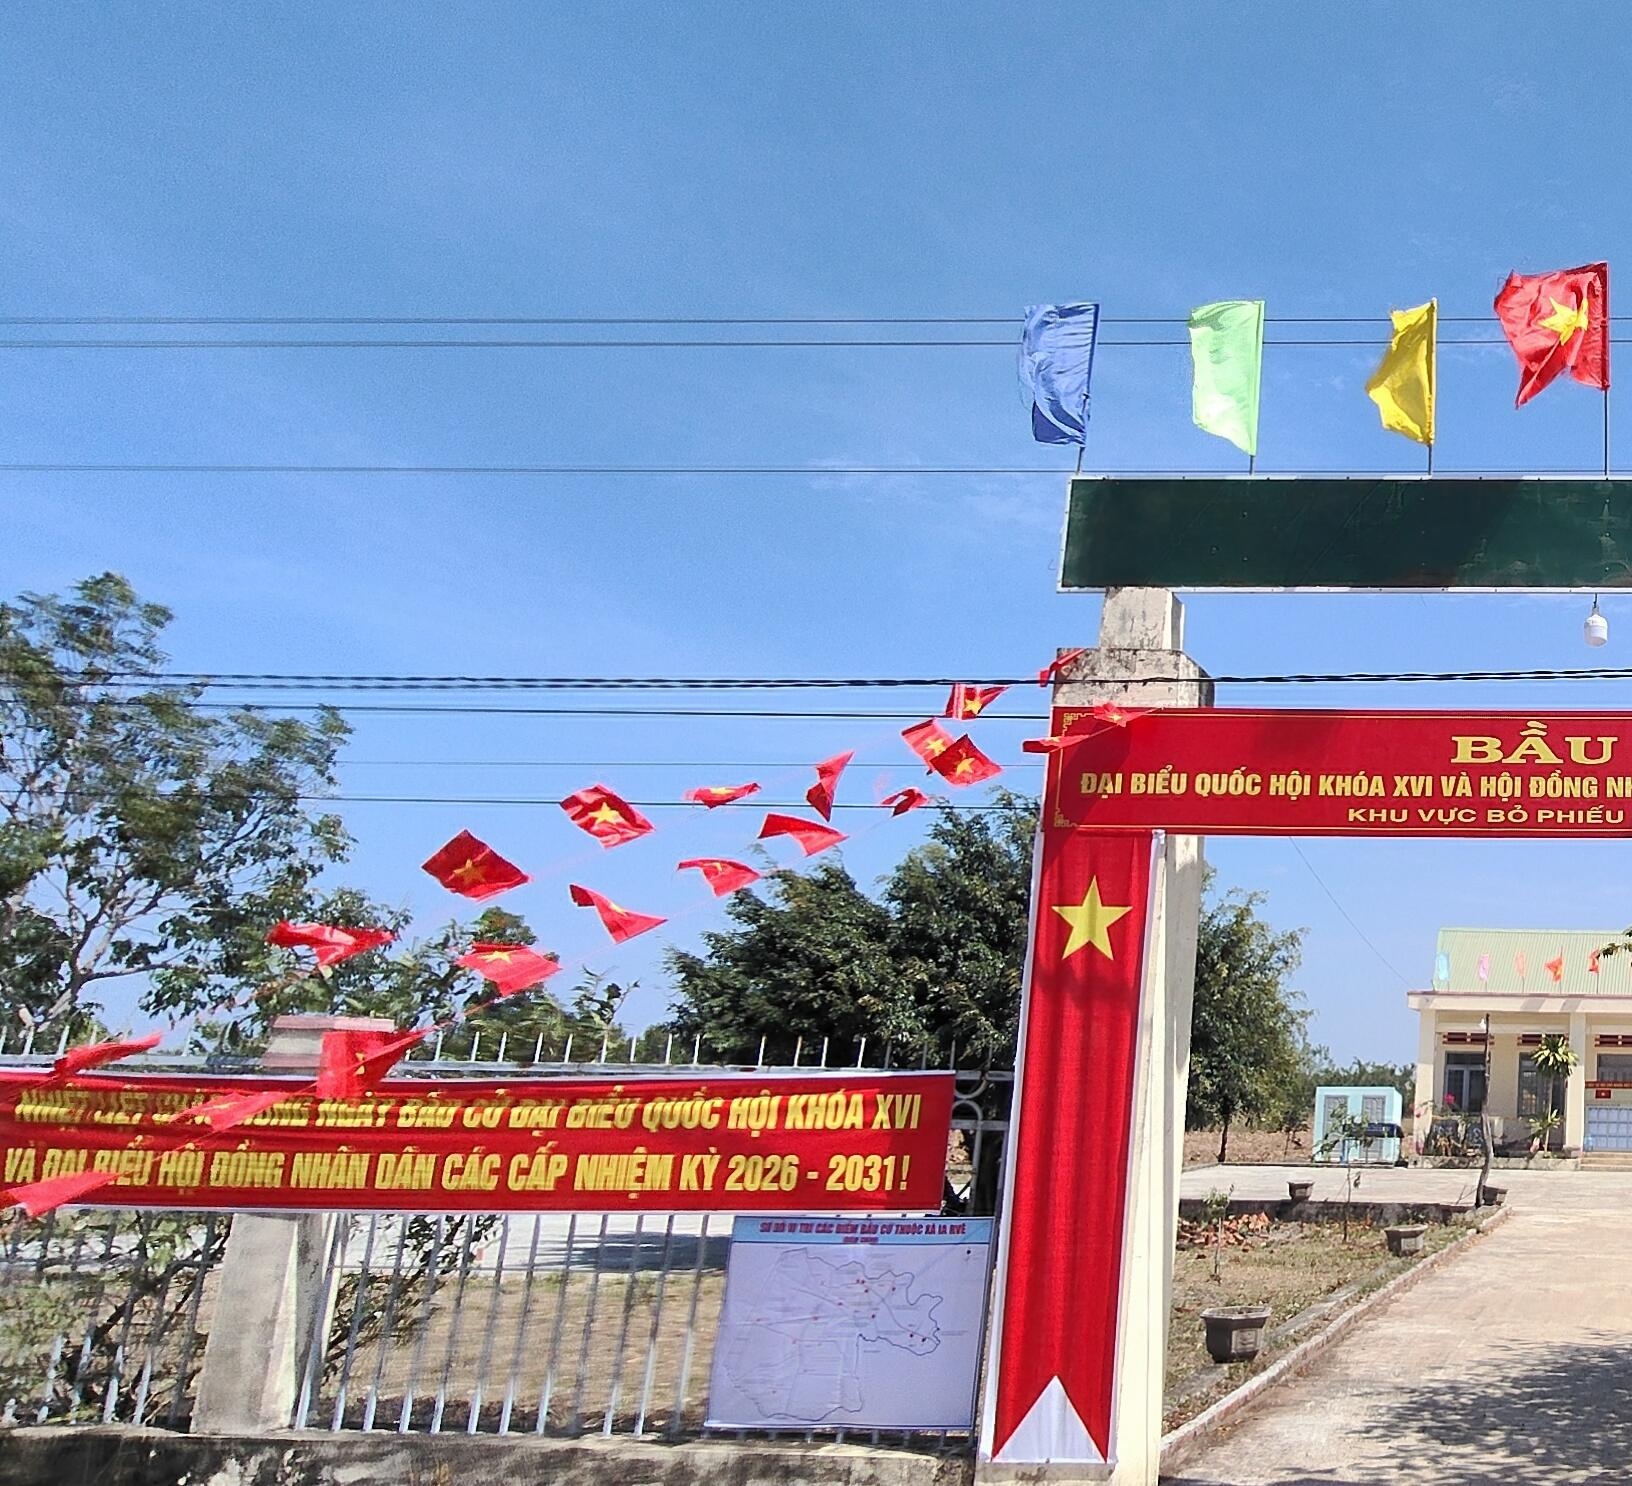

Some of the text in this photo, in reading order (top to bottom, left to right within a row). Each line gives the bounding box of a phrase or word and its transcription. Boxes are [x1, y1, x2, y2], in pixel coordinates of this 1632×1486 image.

[1450, 720, 1618, 765] BẦU
[1080, 772, 1123, 800] ĐẠI
[1129, 764, 1187, 795] BIỂU
[1194, 766, 1262, 797] QUỐC
[1269, 771, 1310, 801] HỘI
[1318, 768, 1386, 798] KHÓA
[1393, 775, 1433, 798] XVI
[1440, 769, 1473, 798] VÀ
[1480, 772, 1522, 802] HỘI
[1529, 765, 1598, 799] ĐỒNG
[1349, 808, 1408, 822] KHU
[1418, 806, 1476, 827] VỰC
[1487, 803, 1528, 824] BỎ
[1538, 801, 1624, 825] PHIẾU
[508, 1098, 566, 1136] ĐẠI
[566, 1085, 642, 1129] BIỂU
[642, 1086, 725, 1132] QUỐC
[727, 1089, 782, 1137] HỘI
[785, 1088, 864, 1130] KHÓA
[872, 1093, 922, 1130] XVI
[157, 1142, 205, 1195] HỘI
[209, 1139, 285, 1188] ĐỒNG
[289, 1145, 370, 1190] NHÂN
[374, 1145, 437, 1190] DÂN
[441, 1146, 502, 1191] CÁC
[507, 1140, 569, 1191] CẤP
[573, 1146, 676, 1200] NHIỆM
[679, 1146, 722, 1192] KỲ
[724, 1154, 800, 1192] 2026
[806, 1170, 819, 1180] -
